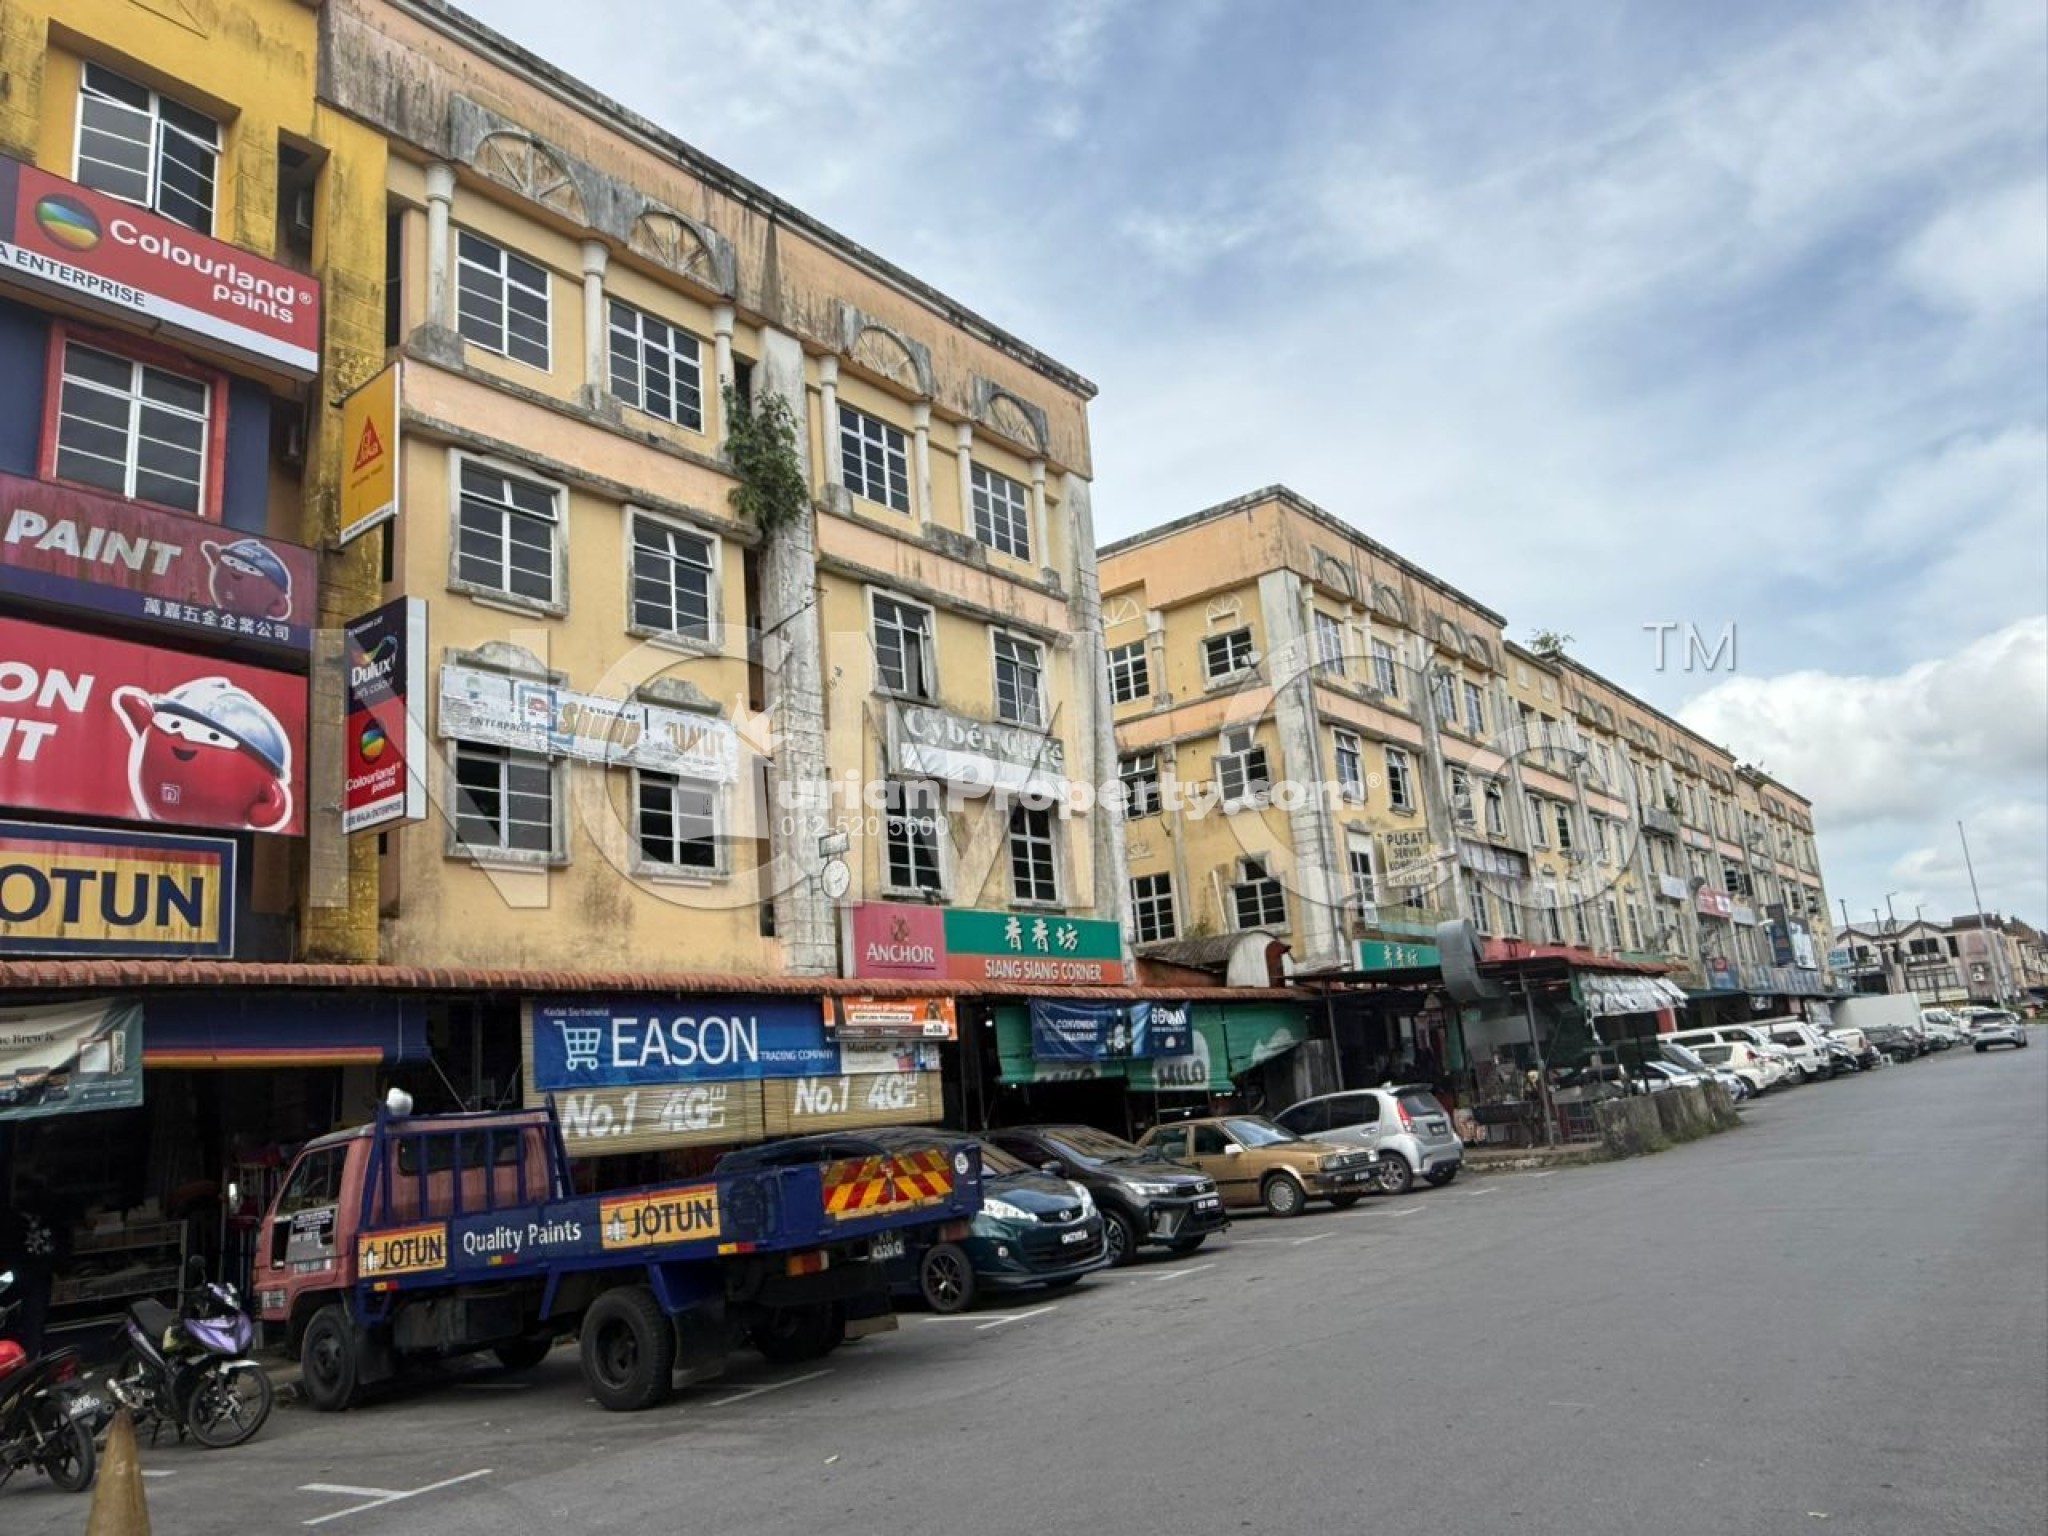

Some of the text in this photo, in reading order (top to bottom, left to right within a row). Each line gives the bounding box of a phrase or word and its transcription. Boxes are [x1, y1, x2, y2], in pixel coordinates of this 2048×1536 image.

[16, 250, 145, 307] ENTERPRISE
[213, 283, 294, 324] paints
[4, 509, 182, 576] PAINT
[351, 656, 392, 687] Dulux
[1386, 831, 1425, 846] PUSAT
[866, 943, 935, 963] ANCHOR
[985, 959, 1102, 981] SIANG SIANG CORNER
[612, 1016, 758, 1068] EASON
[761, 1051, 796, 1061] TRADING
[1157, 1059, 1206, 1086] MILO
[794, 1077, 850, 1115] No.1
[561, 1090, 640, 1140] No.1
[631, 1198, 714, 1239] JOTUN
[381, 1236, 442, 1268] JOTUN
[463, 1219, 583, 1255] Quality Paints
